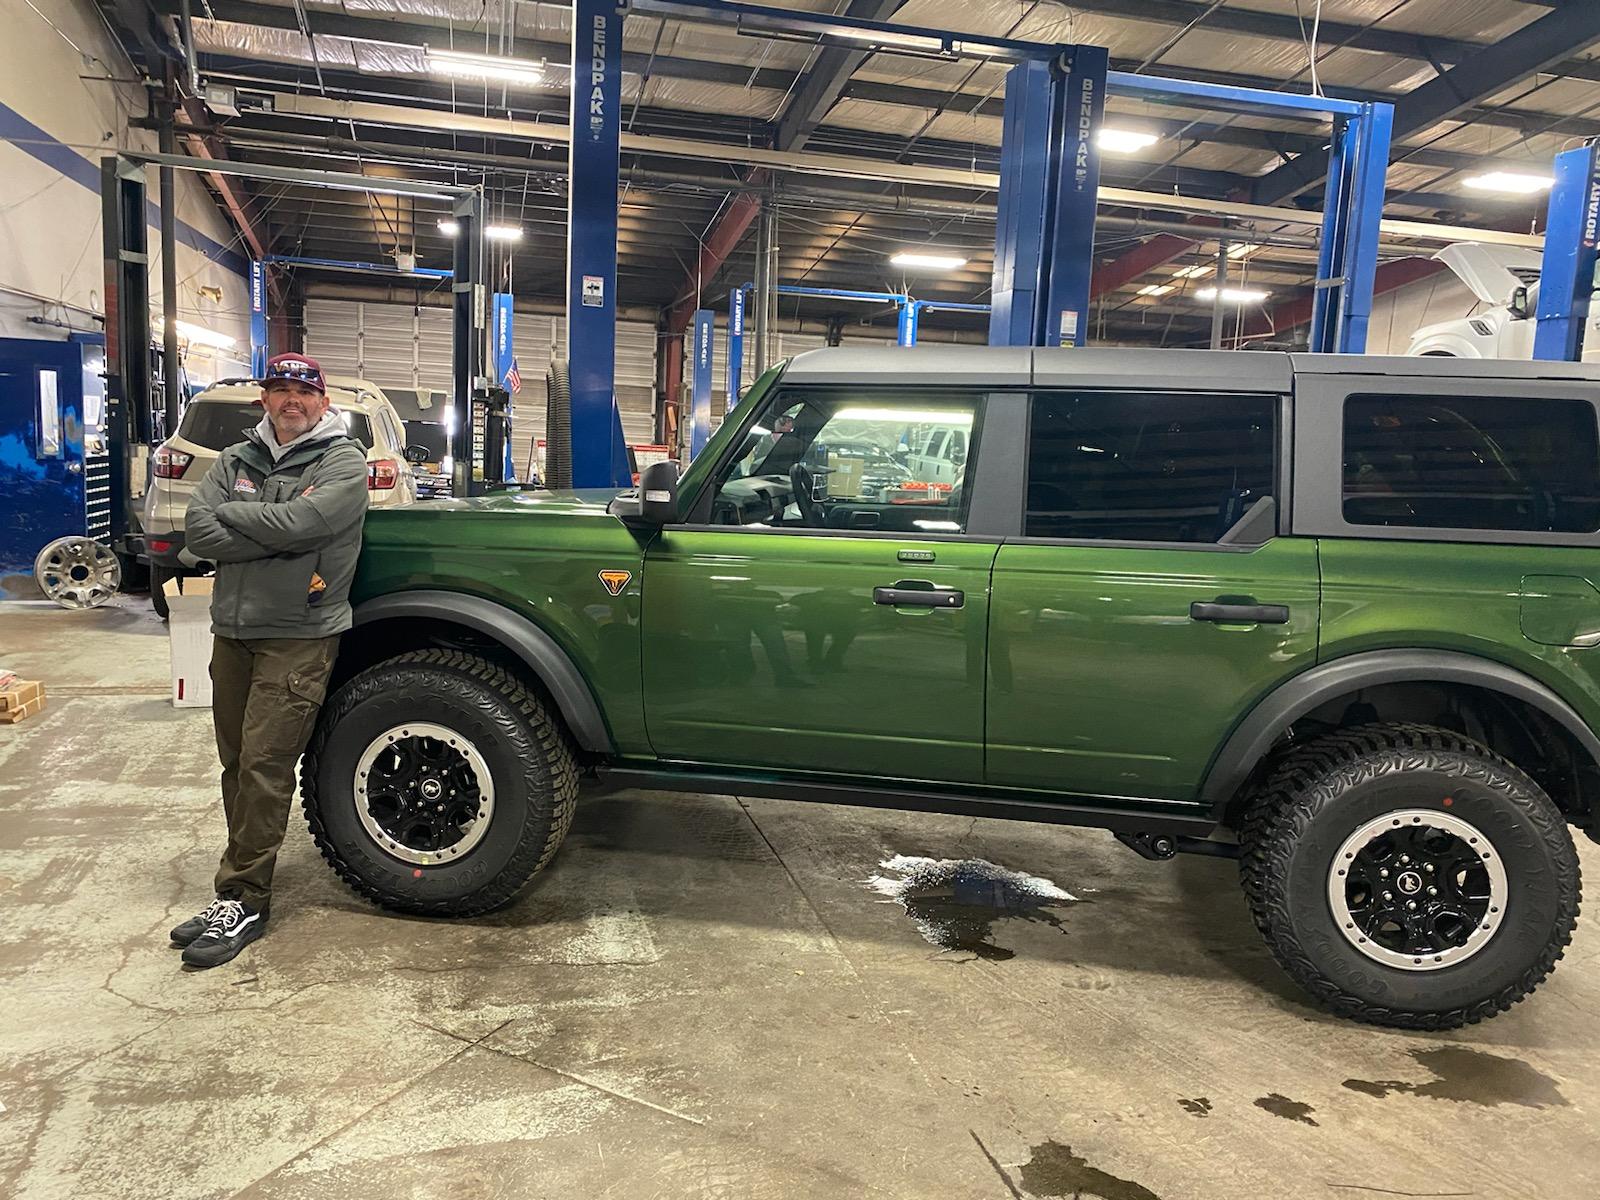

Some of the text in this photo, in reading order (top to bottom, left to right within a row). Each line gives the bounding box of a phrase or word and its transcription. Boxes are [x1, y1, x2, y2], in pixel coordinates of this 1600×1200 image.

[590, 15, 606, 115] BENDPAK
[1076, 79, 1093, 168] BENDPAK
[253, 261, 261, 308] ROTARY LIFT
[734, 289, 743, 332] ROTARY LIFT
[273, 360, 309, 373] VANS
